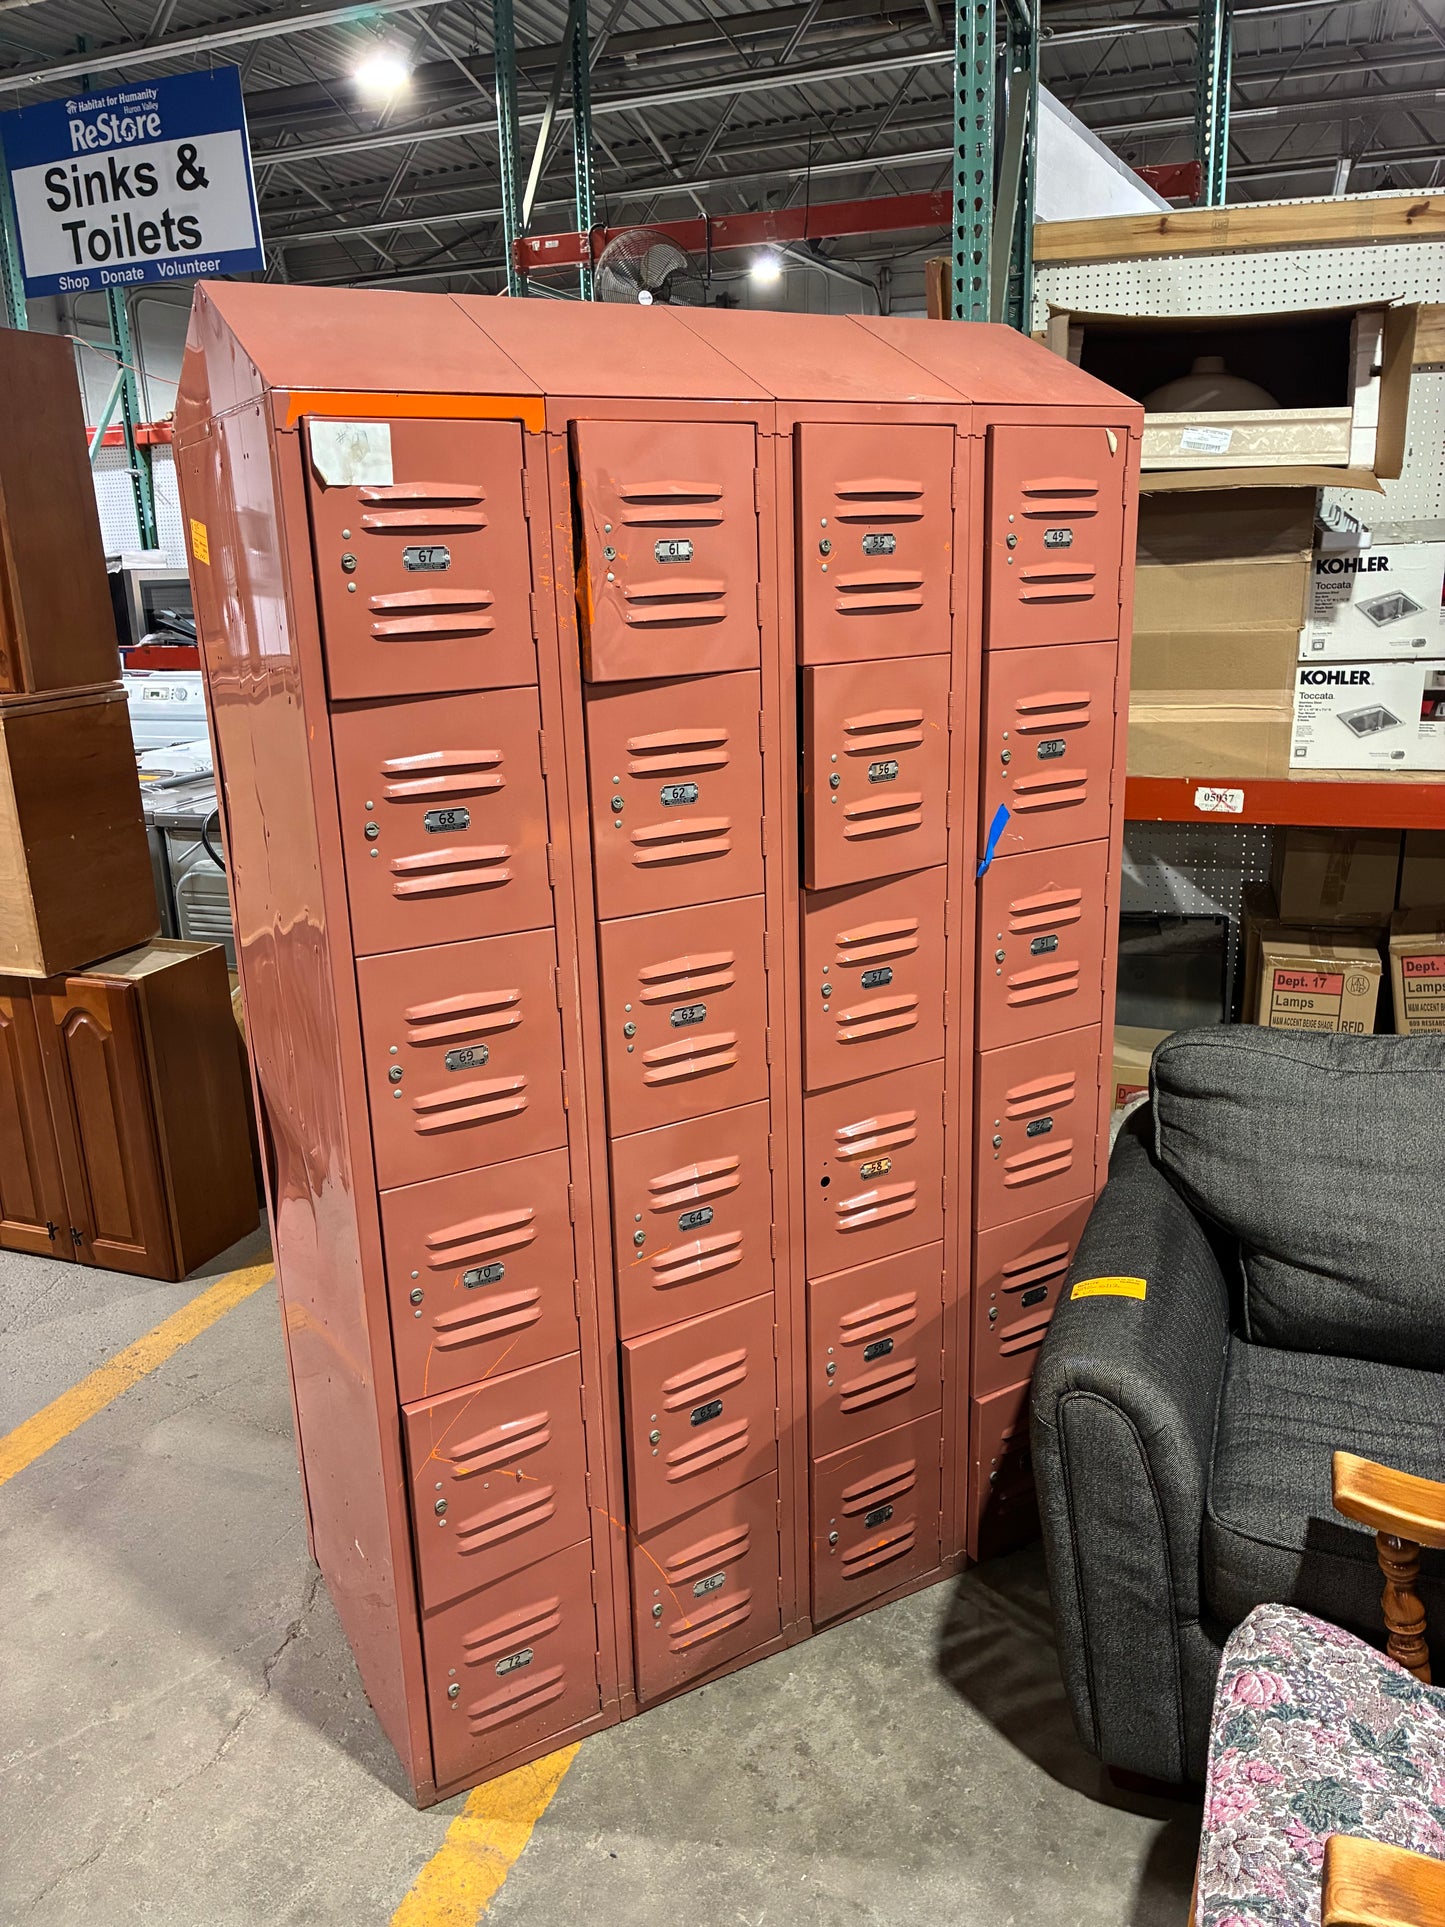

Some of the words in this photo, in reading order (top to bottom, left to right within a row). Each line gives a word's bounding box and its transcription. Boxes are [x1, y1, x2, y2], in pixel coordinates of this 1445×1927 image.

[78, 97, 106, 113] Habitat
[107, 95, 118, 107] for
[119, 88, 157, 104] Humanity
[123, 104, 141, 114] Huron
[141, 102, 159, 111] Valley
[69, 112, 162, 152] ReStore
[44, 157, 159, 213] Sinks
[176, 143, 210, 191] &
[62, 208, 203, 265] Toilets
[59, 274, 90, 291] Shop
[100, 266, 145, 285] Donate
[157, 257, 221, 277] Volunteer
[872, 536, 885, 548] 55
[1052, 531, 1064, 542] 49
[669, 543, 679, 555] 61
[418, 550, 433, 563] 67
[1315, 556, 1389, 575] KOHLER
[1315, 581, 1352, 590] Toccata
[1300, 670, 1371, 686] KOHLER
[1299, 692, 1334, 700] Toccata
[1046, 742, 1057, 753] 50
[878, 763, 889, 775] 56
[672, 787, 685, 799] 62
[438, 812, 456, 825] 68
[1040, 938, 1048, 949] 51
[1406, 961, 1440, 974] Dept.
[871, 971, 883, 982] 57
[1277, 975, 1308, 988] Dept.
[1313, 976, 1327, 989] 17
[1275, 995, 1314, 1010] Lamps
[1420, 1003, 1440, 1012] ACCENT
[681, 1008, 695, 1020] 63
[1284, 1017, 1302, 1027] ACCENT
[1302, 1018, 1317, 1028] BEIGE
[1317, 1020, 1333, 1030] SHADE
[1341, 1020, 1364, 1033] RFID
[459, 1050, 474, 1063] 69
[871, 1161, 882, 1173] 58
[689, 1212, 703, 1223] 64
[476, 1268, 491, 1280] 70
[700, 1406, 712, 1417] 65
[704, 1578, 715, 1589] 66
[508, 1655, 521, 1668] 72
